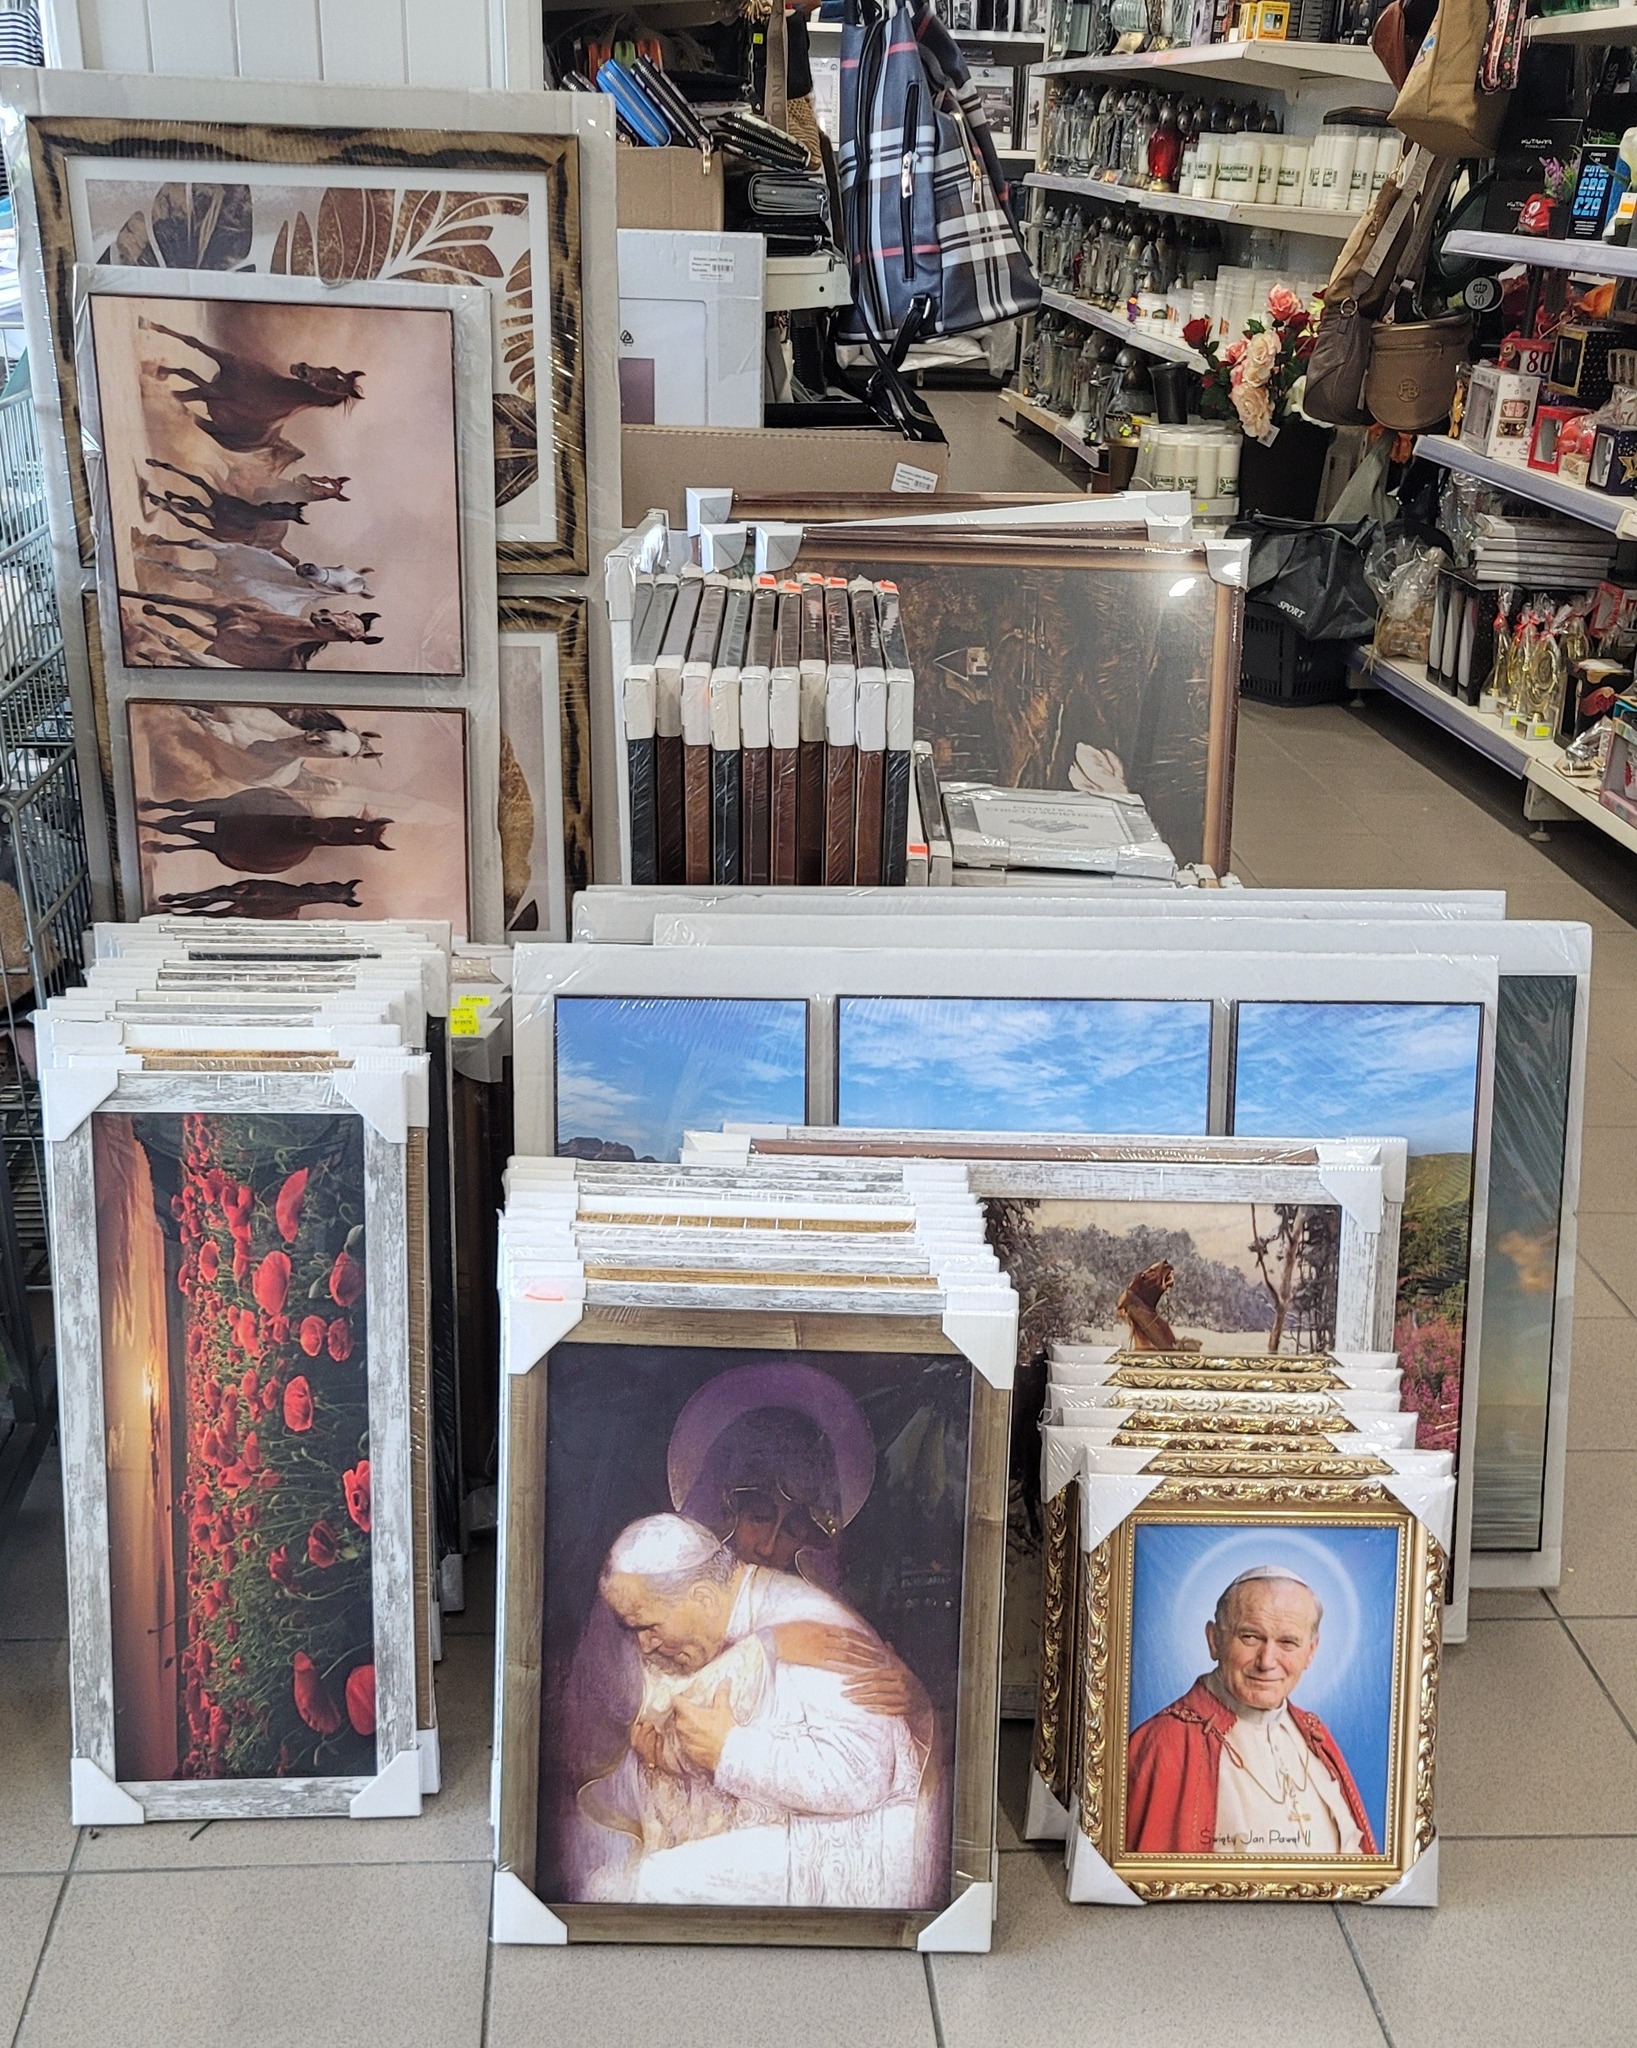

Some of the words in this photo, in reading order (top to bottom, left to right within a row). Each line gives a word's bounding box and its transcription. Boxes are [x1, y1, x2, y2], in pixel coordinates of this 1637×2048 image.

[1572, 196, 1602, 217] CZA
[1471, 294, 1486, 307] 50
[1526, 350, 1552, 374] 80
[1278, 601, 1306, 618] SPORT
[1240, 1829, 1265, 1844] Jan
